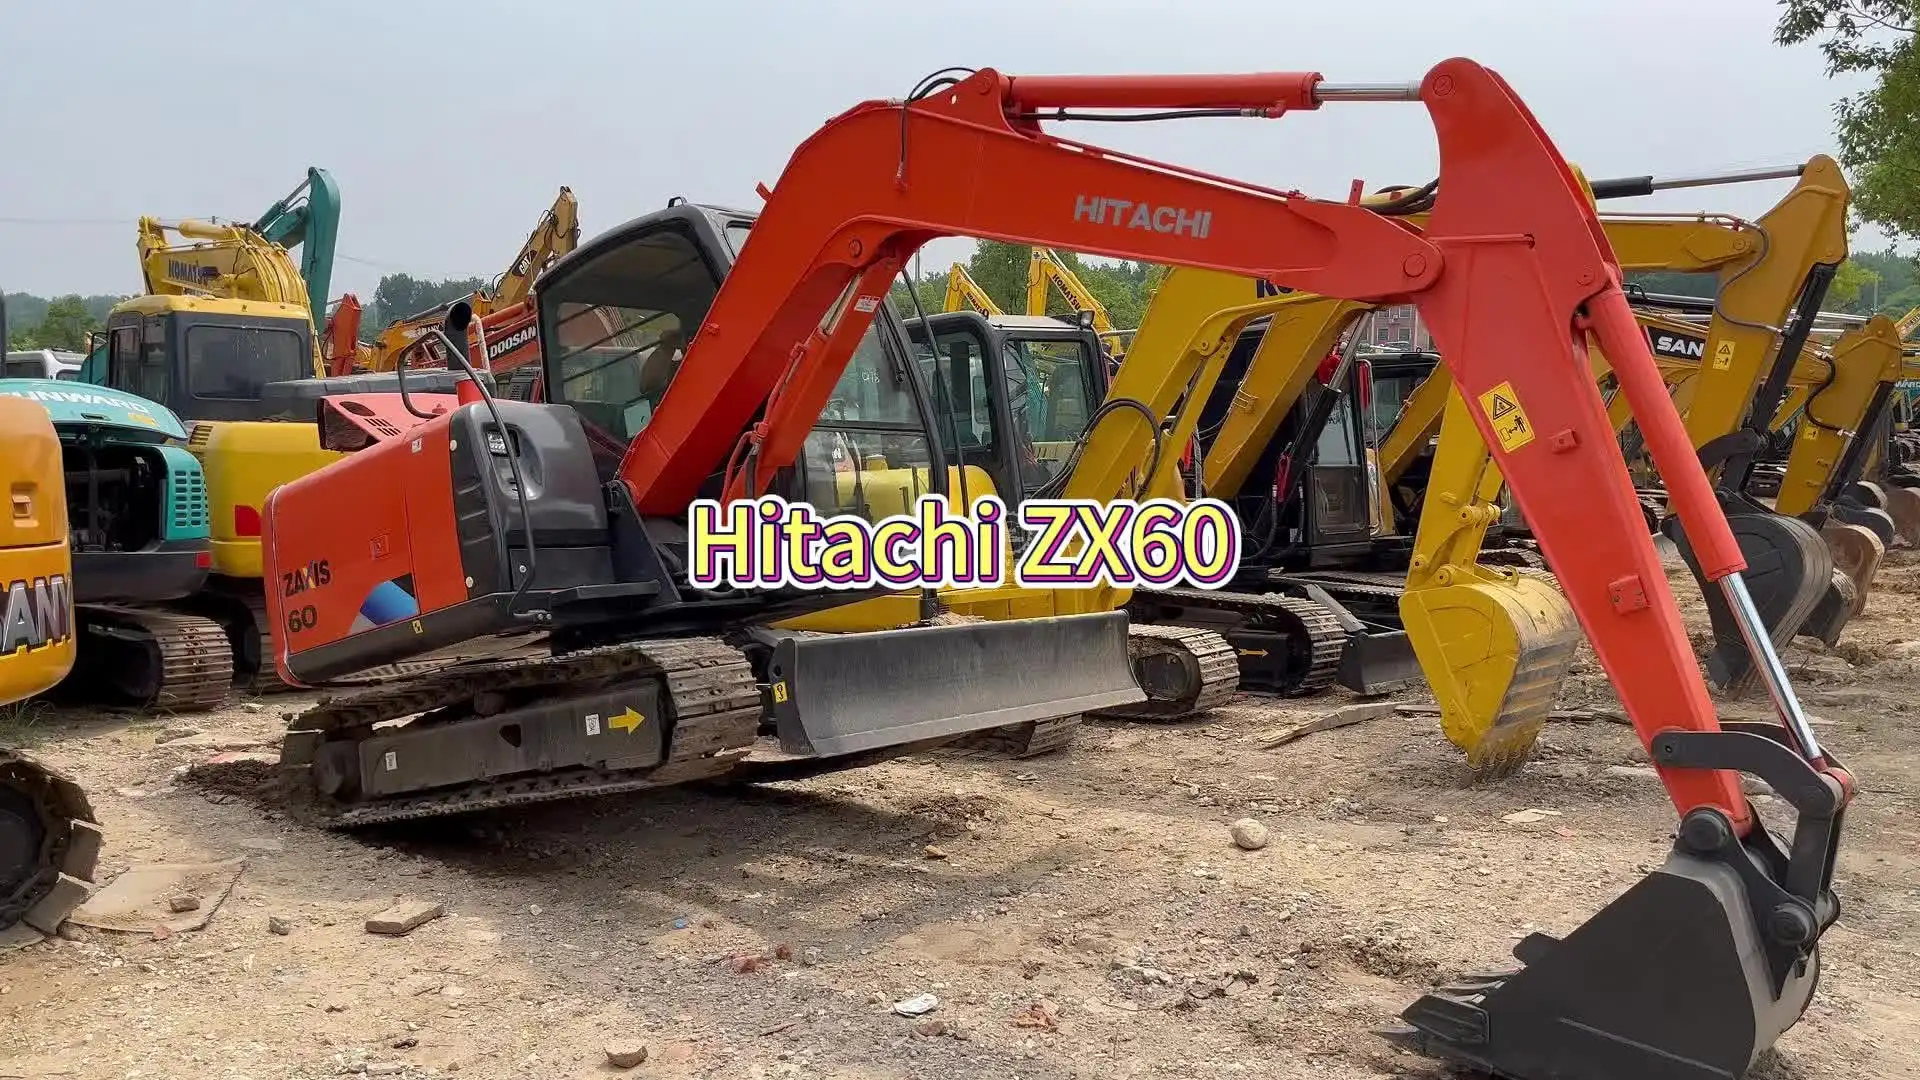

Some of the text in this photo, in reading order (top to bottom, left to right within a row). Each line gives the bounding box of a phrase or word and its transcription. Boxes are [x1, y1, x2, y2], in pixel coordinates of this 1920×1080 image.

[1074, 193, 1212, 239] HITACHI
[489, 326, 537, 359] DOOSAN
[284, 558, 332, 597] ZAXIS
[0, 575, 72, 654] ANY
[288, 605, 318, 633] 60
